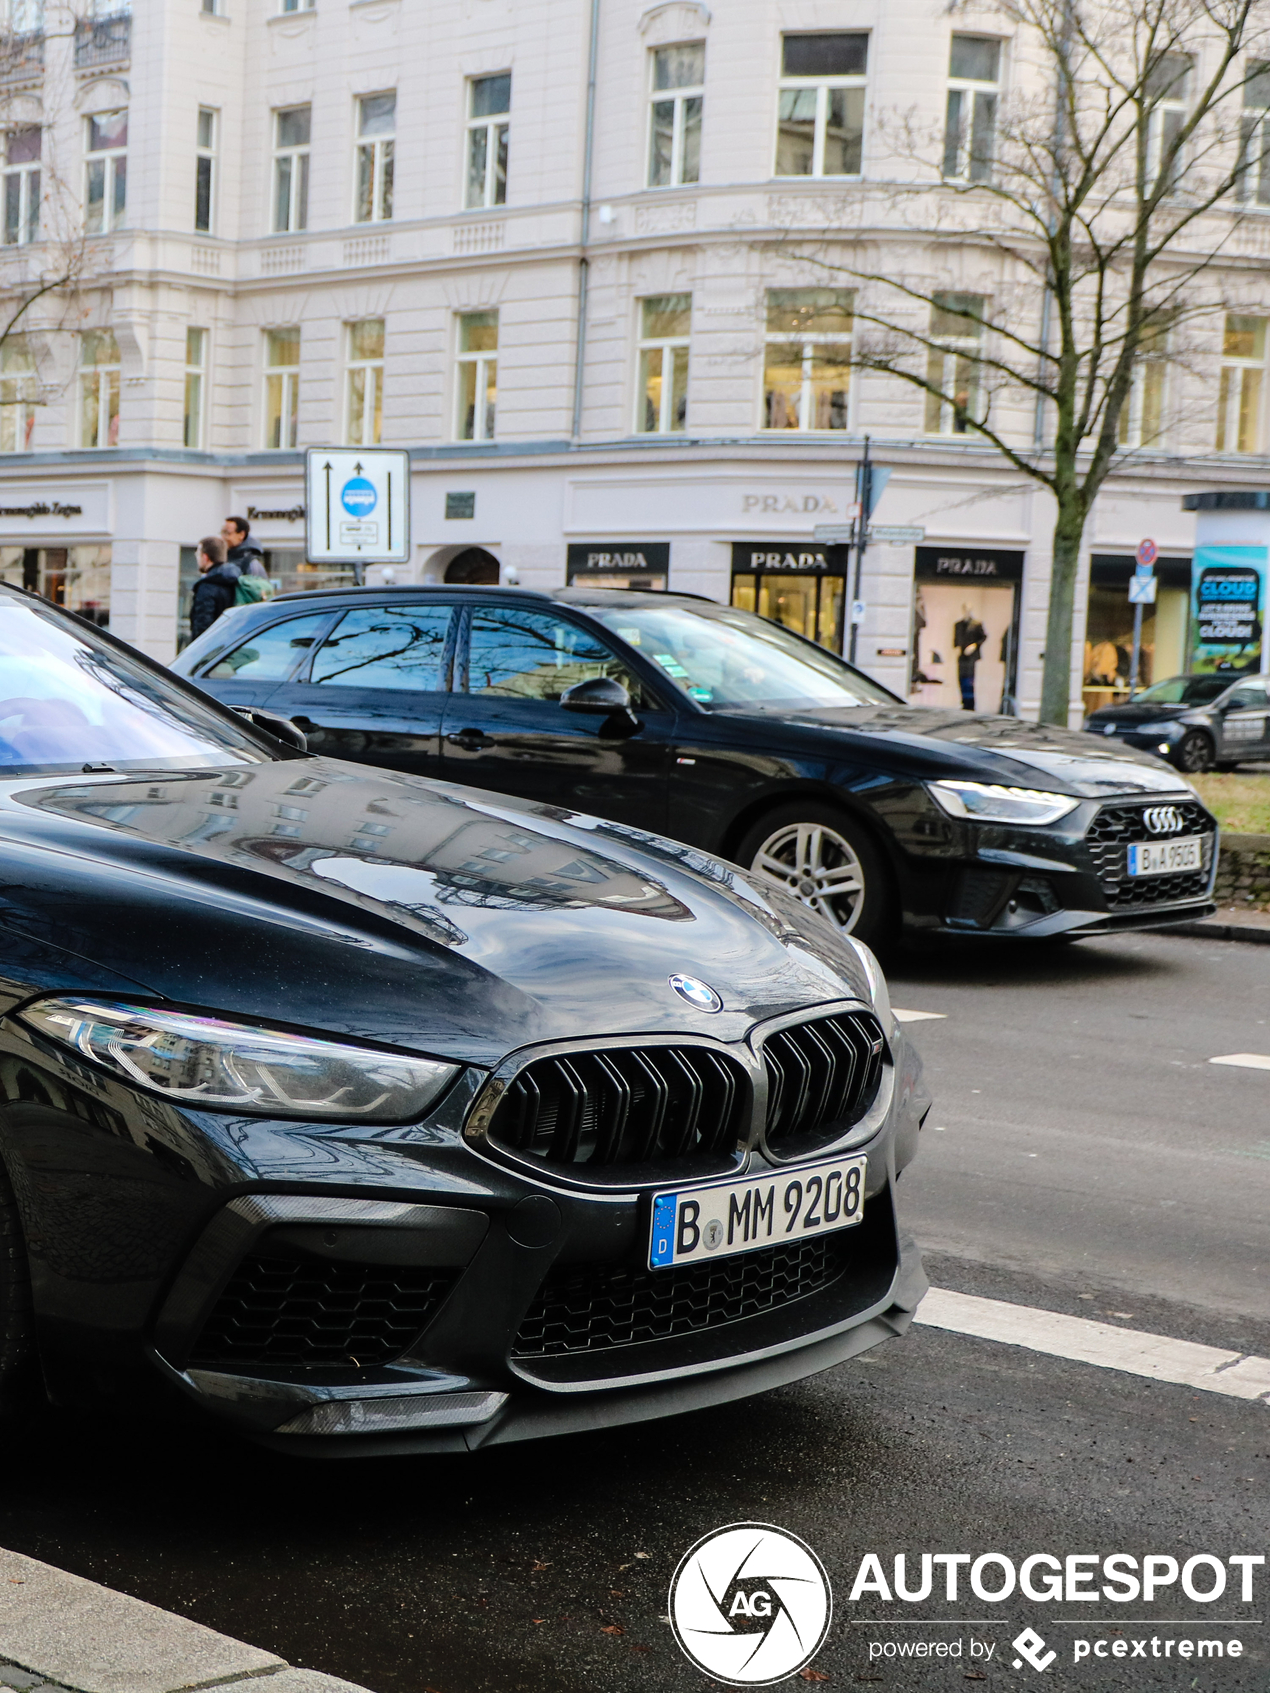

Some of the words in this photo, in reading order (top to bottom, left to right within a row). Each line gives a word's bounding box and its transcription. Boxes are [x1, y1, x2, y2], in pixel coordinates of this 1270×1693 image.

[742, 495, 838, 513] PRADA
[587, 552, 647, 568] PRADA
[750, 552, 828, 569] PRADA
[936, 557, 998, 576] PRADA
[1200, 582, 1257, 595] CLOUD
[1142, 849, 1150, 871] B
[676, 1200, 700, 1254] B
[728, 1185, 775, 1245] MM
[783, 1166, 861, 1233] 9208
[658, 1239, 667, 1254] D
